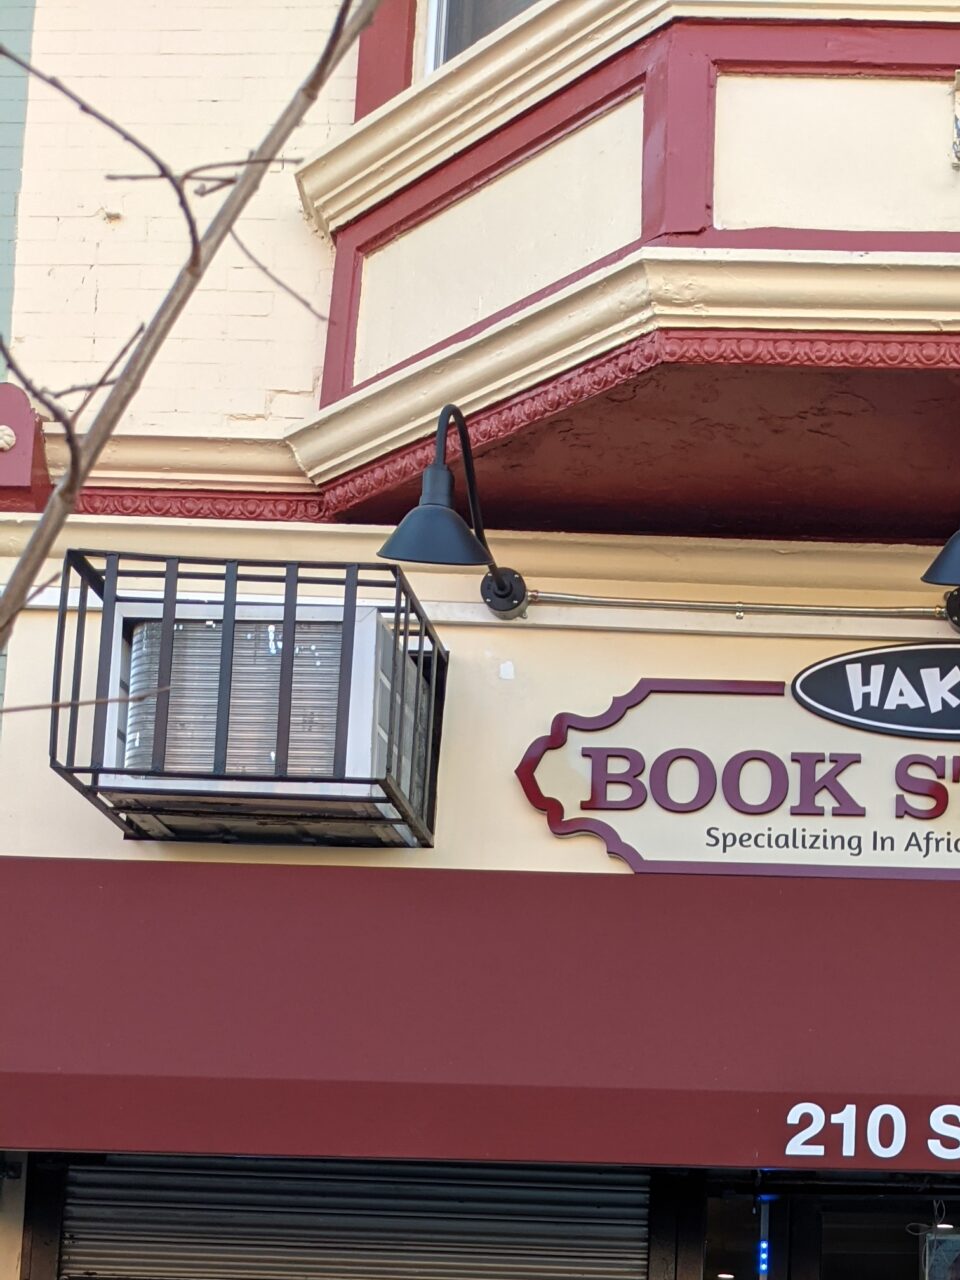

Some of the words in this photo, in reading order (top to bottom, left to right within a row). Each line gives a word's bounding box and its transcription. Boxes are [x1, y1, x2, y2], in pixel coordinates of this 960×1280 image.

[581, 745, 864, 818] BOOK
[705, 826, 863, 857] Specializing
[871, 828, 896, 854] In
[785, 1102, 907, 1158] 210
